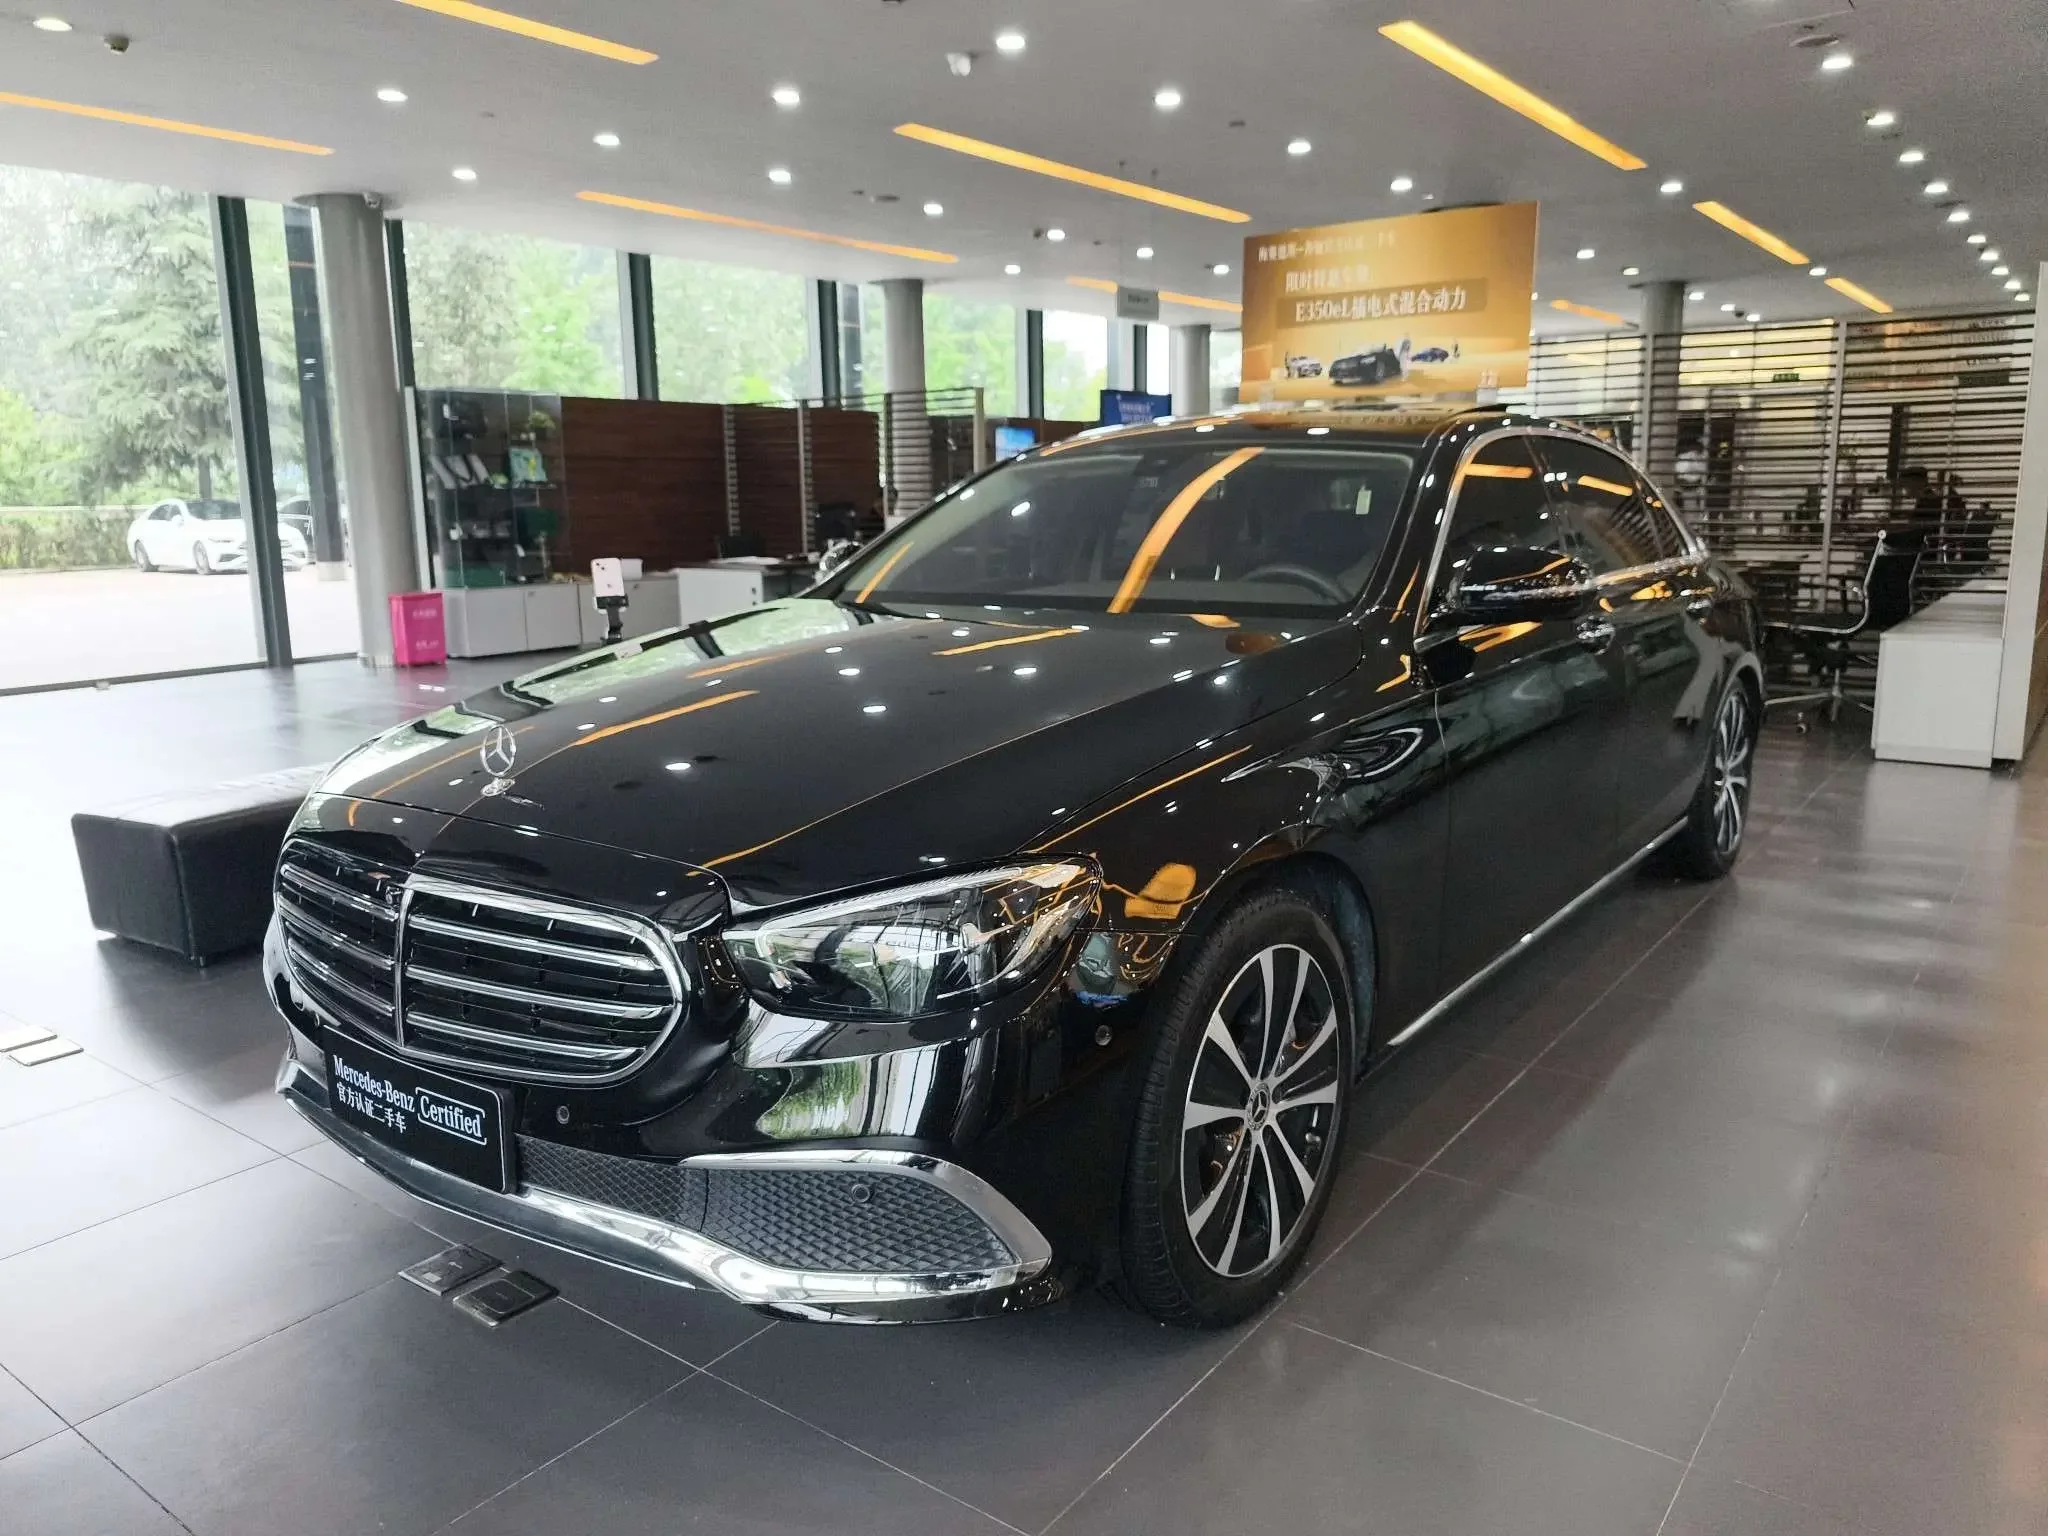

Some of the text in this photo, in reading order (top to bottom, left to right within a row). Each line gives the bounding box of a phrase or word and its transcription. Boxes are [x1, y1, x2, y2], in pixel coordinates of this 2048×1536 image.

[333, 1055, 482, 1137] Mercedes-Benz Certified
[336, 1082, 407, 1134] 官方认证二手车
